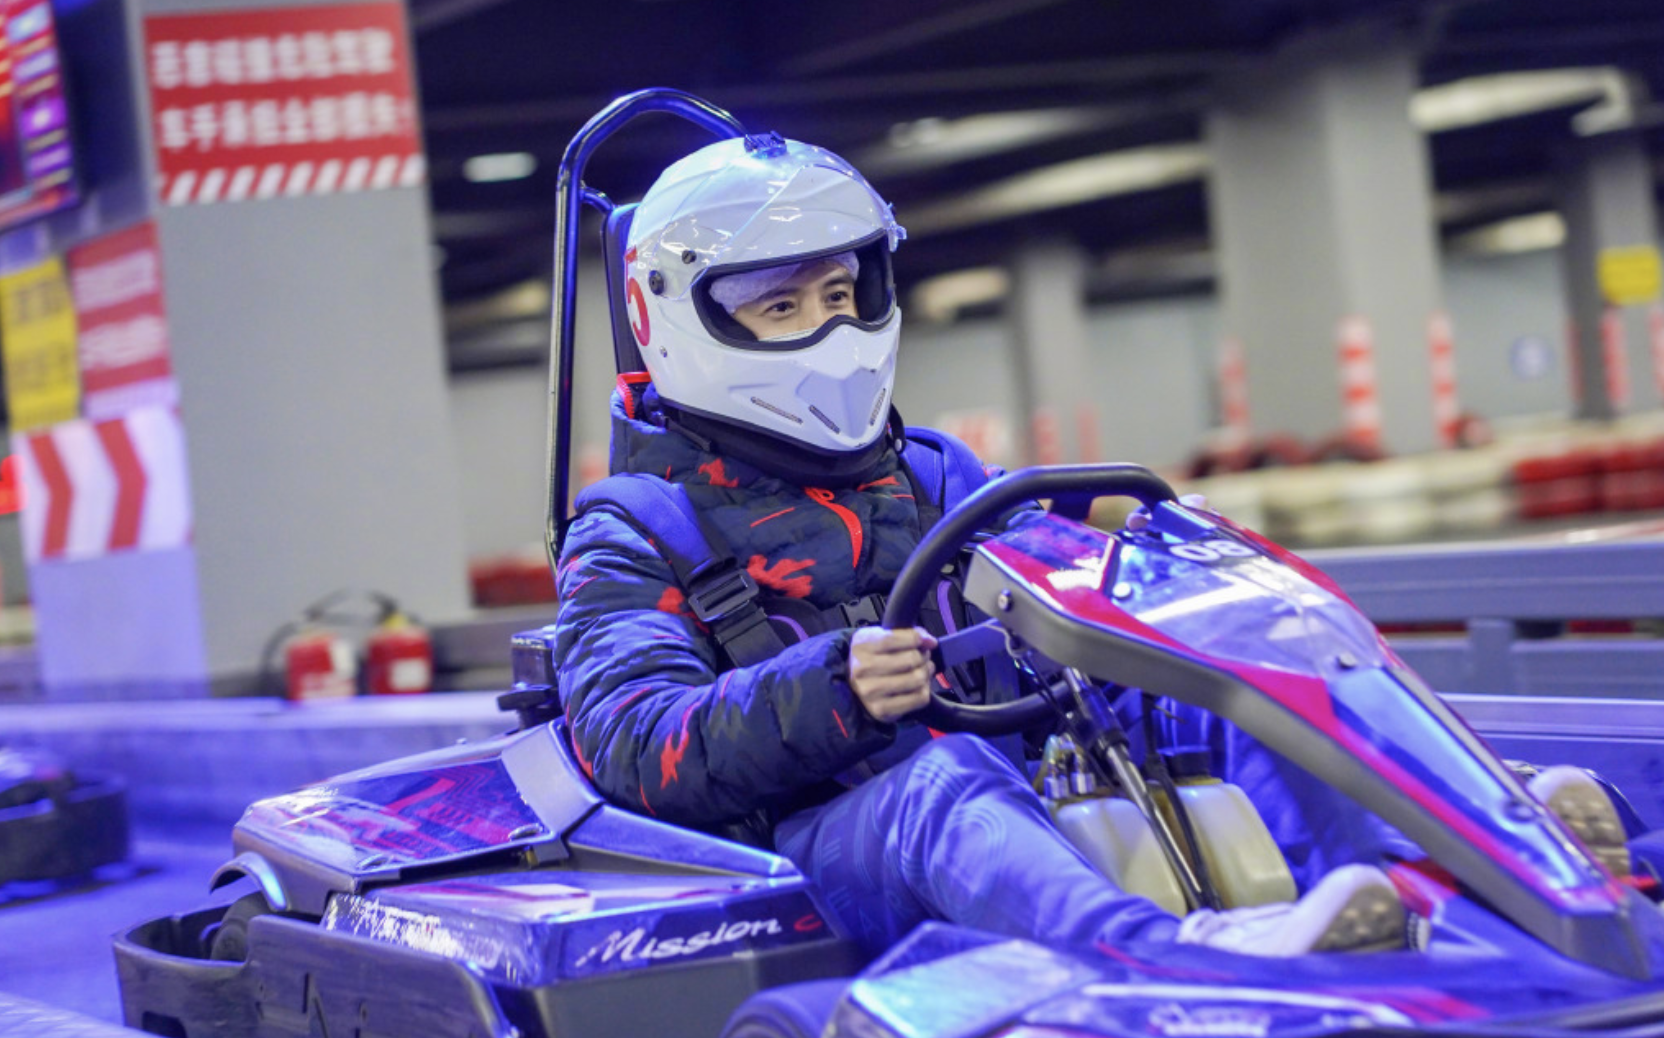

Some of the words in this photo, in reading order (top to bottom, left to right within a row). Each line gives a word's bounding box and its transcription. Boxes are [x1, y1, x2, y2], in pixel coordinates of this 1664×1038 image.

[624, 246, 650, 346] 5
[1168, 539, 1257, 562] 08
[574, 918, 782, 968] Mission
